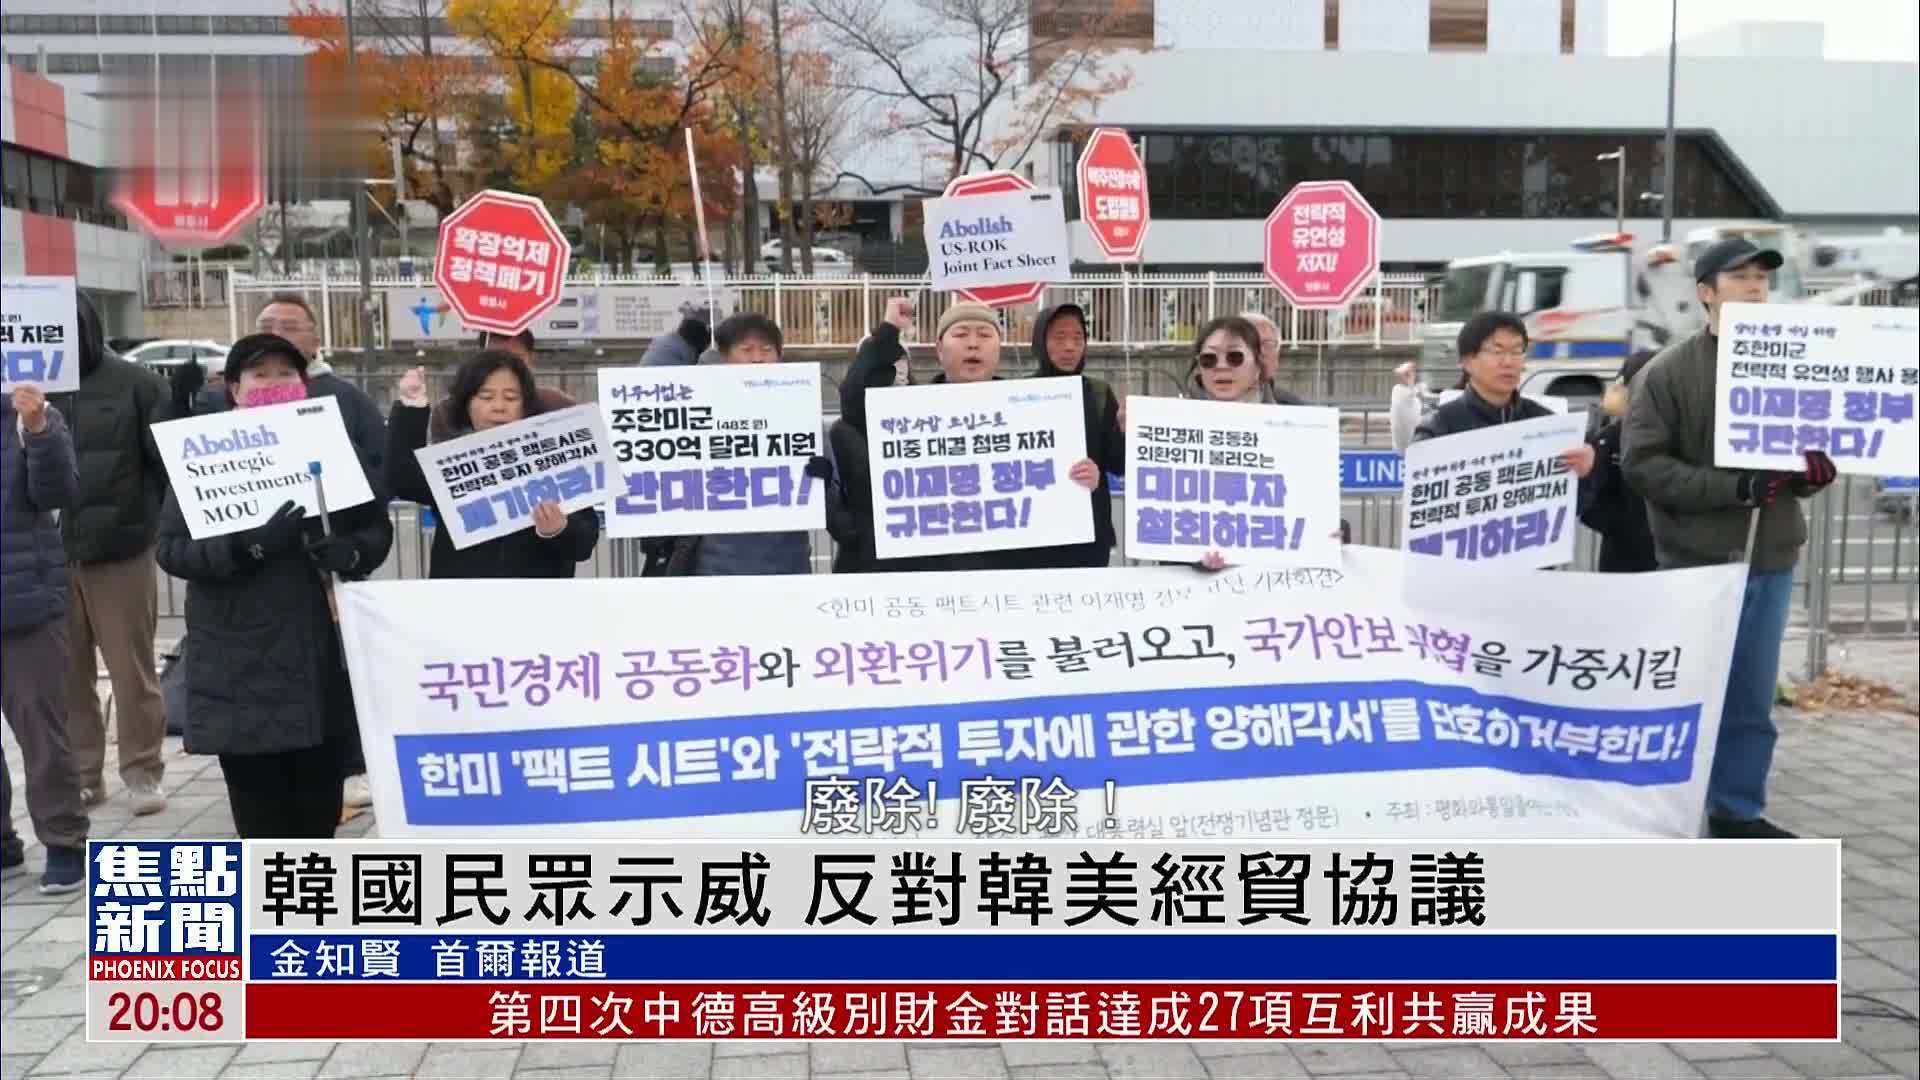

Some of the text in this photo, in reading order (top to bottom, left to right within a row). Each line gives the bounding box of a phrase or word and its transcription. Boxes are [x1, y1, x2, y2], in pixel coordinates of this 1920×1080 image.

[940, 216, 1013, 239] Abolish
[1293, 203, 1346, 225] 전략적
[455, 227, 550, 267] 확장억제
[941, 239, 1007, 256] US-ROK
[1292, 226, 1345, 248] 유연성
[450, 256, 545, 296] 정책폐기
[943, 253, 1056, 277] Joint Fact Sheet
[1296, 252, 1339, 272] 저지!
[21, 325, 64, 343] 지원
[1732, 339, 1806, 359] 주한미군
[1, 350, 64, 383] 다!
[1731, 361, 1787, 379] 전략적
[1792, 363, 1849, 382] 유연성
[1856, 366, 1894, 384] 행사
[611, 406, 713, 433] 주한미군
[1729, 386, 1914, 423] 이재명 정부
[181, 424, 280, 459] Abolish
[613, 432, 816, 462] 330억 달러 지원
[883, 430, 1055, 459] 미중 대결 첨병 자처
[1136, 424, 1259, 448] 국민경제 공동화
[1728, 422, 1884, 458] 규탄한다!
[186, 451, 275, 478] Strategic
[441, 461, 479, 484] 한미
[482, 447, 519, 470] 공동
[522, 427, 593, 457] 팩트시트
[1136, 445, 1275, 469] 외환위기 불러오는
[194, 471, 312, 501] Investments
[449, 475, 498, 500] 전략적
[501, 465, 533, 480] 투자
[535, 443, 598, 472] 양해각서
[882, 458, 1056, 500] 이재명 정부
[1411, 479, 1449, 506] 한미
[1454, 469, 1492, 496] 공동
[1496, 454, 1570, 484] 팩트시트
[615, 465, 813, 516] 반대한다!
[1136, 466, 1287, 508] 대미투자
[203, 499, 259, 525] MOU
[885, 497, 1033, 538] 규탄한다!
[1409, 478, 1568, 529] 전략적 투자 양해각서
[1136, 506, 1306, 551] 철회하라!
[885, 595, 929, 618] 공동
[935, 593, 1025, 616] 팩트시트
[1081, 591, 1145, 611] 이재명
[420, 651, 601, 712] 국민경제
[615, 646, 801, 701] 공동화와
[812, 637, 1036, 686] 외환위기를
[1047, 623, 1237, 673] 불러오고,
[1244, 613, 1404, 663] 국가안보
[1522, 643, 1683, 692] 가중시킬
[417, 750, 502, 798] 한미
[511, 745, 615, 795] '팩트
[627, 735, 781, 789] 시트'와
[790, 723, 944, 778] '전략적
[957, 712, 1096, 767] 투자에
[1107, 706, 1197, 757] 관한
[1205, 696, 1421, 751] 양해각서'를
